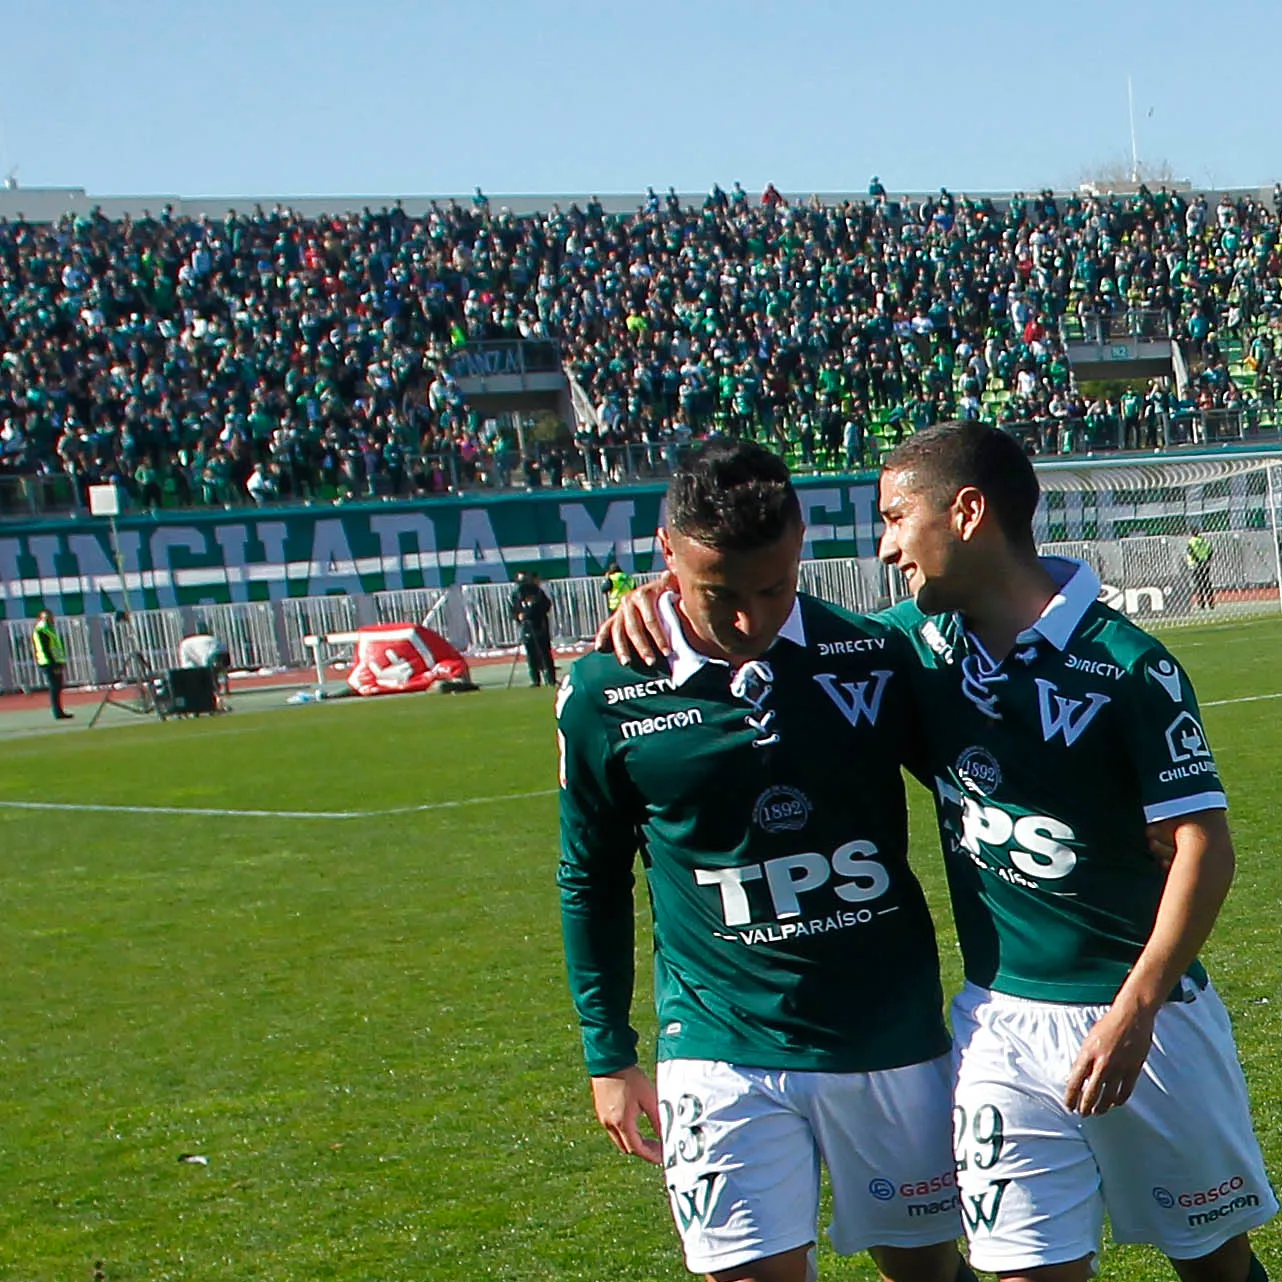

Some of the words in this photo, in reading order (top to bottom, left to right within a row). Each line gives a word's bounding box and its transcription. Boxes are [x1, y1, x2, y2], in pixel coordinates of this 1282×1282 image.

[817, 638, 886, 656] DIRECTV
[1064, 653, 1126, 681] DIRECTV
[603, 678, 677, 705] DIRECTV
[620, 708, 702, 740] macron
[763, 800, 803, 821] 1892
[694, 840, 890, 926] TPS
[740, 908, 872, 945] VALPARAÍSO
[899, 1170, 957, 1198] Gasc
[907, 1196, 957, 1217] macr
[1188, 1192, 1260, 1226] macron
